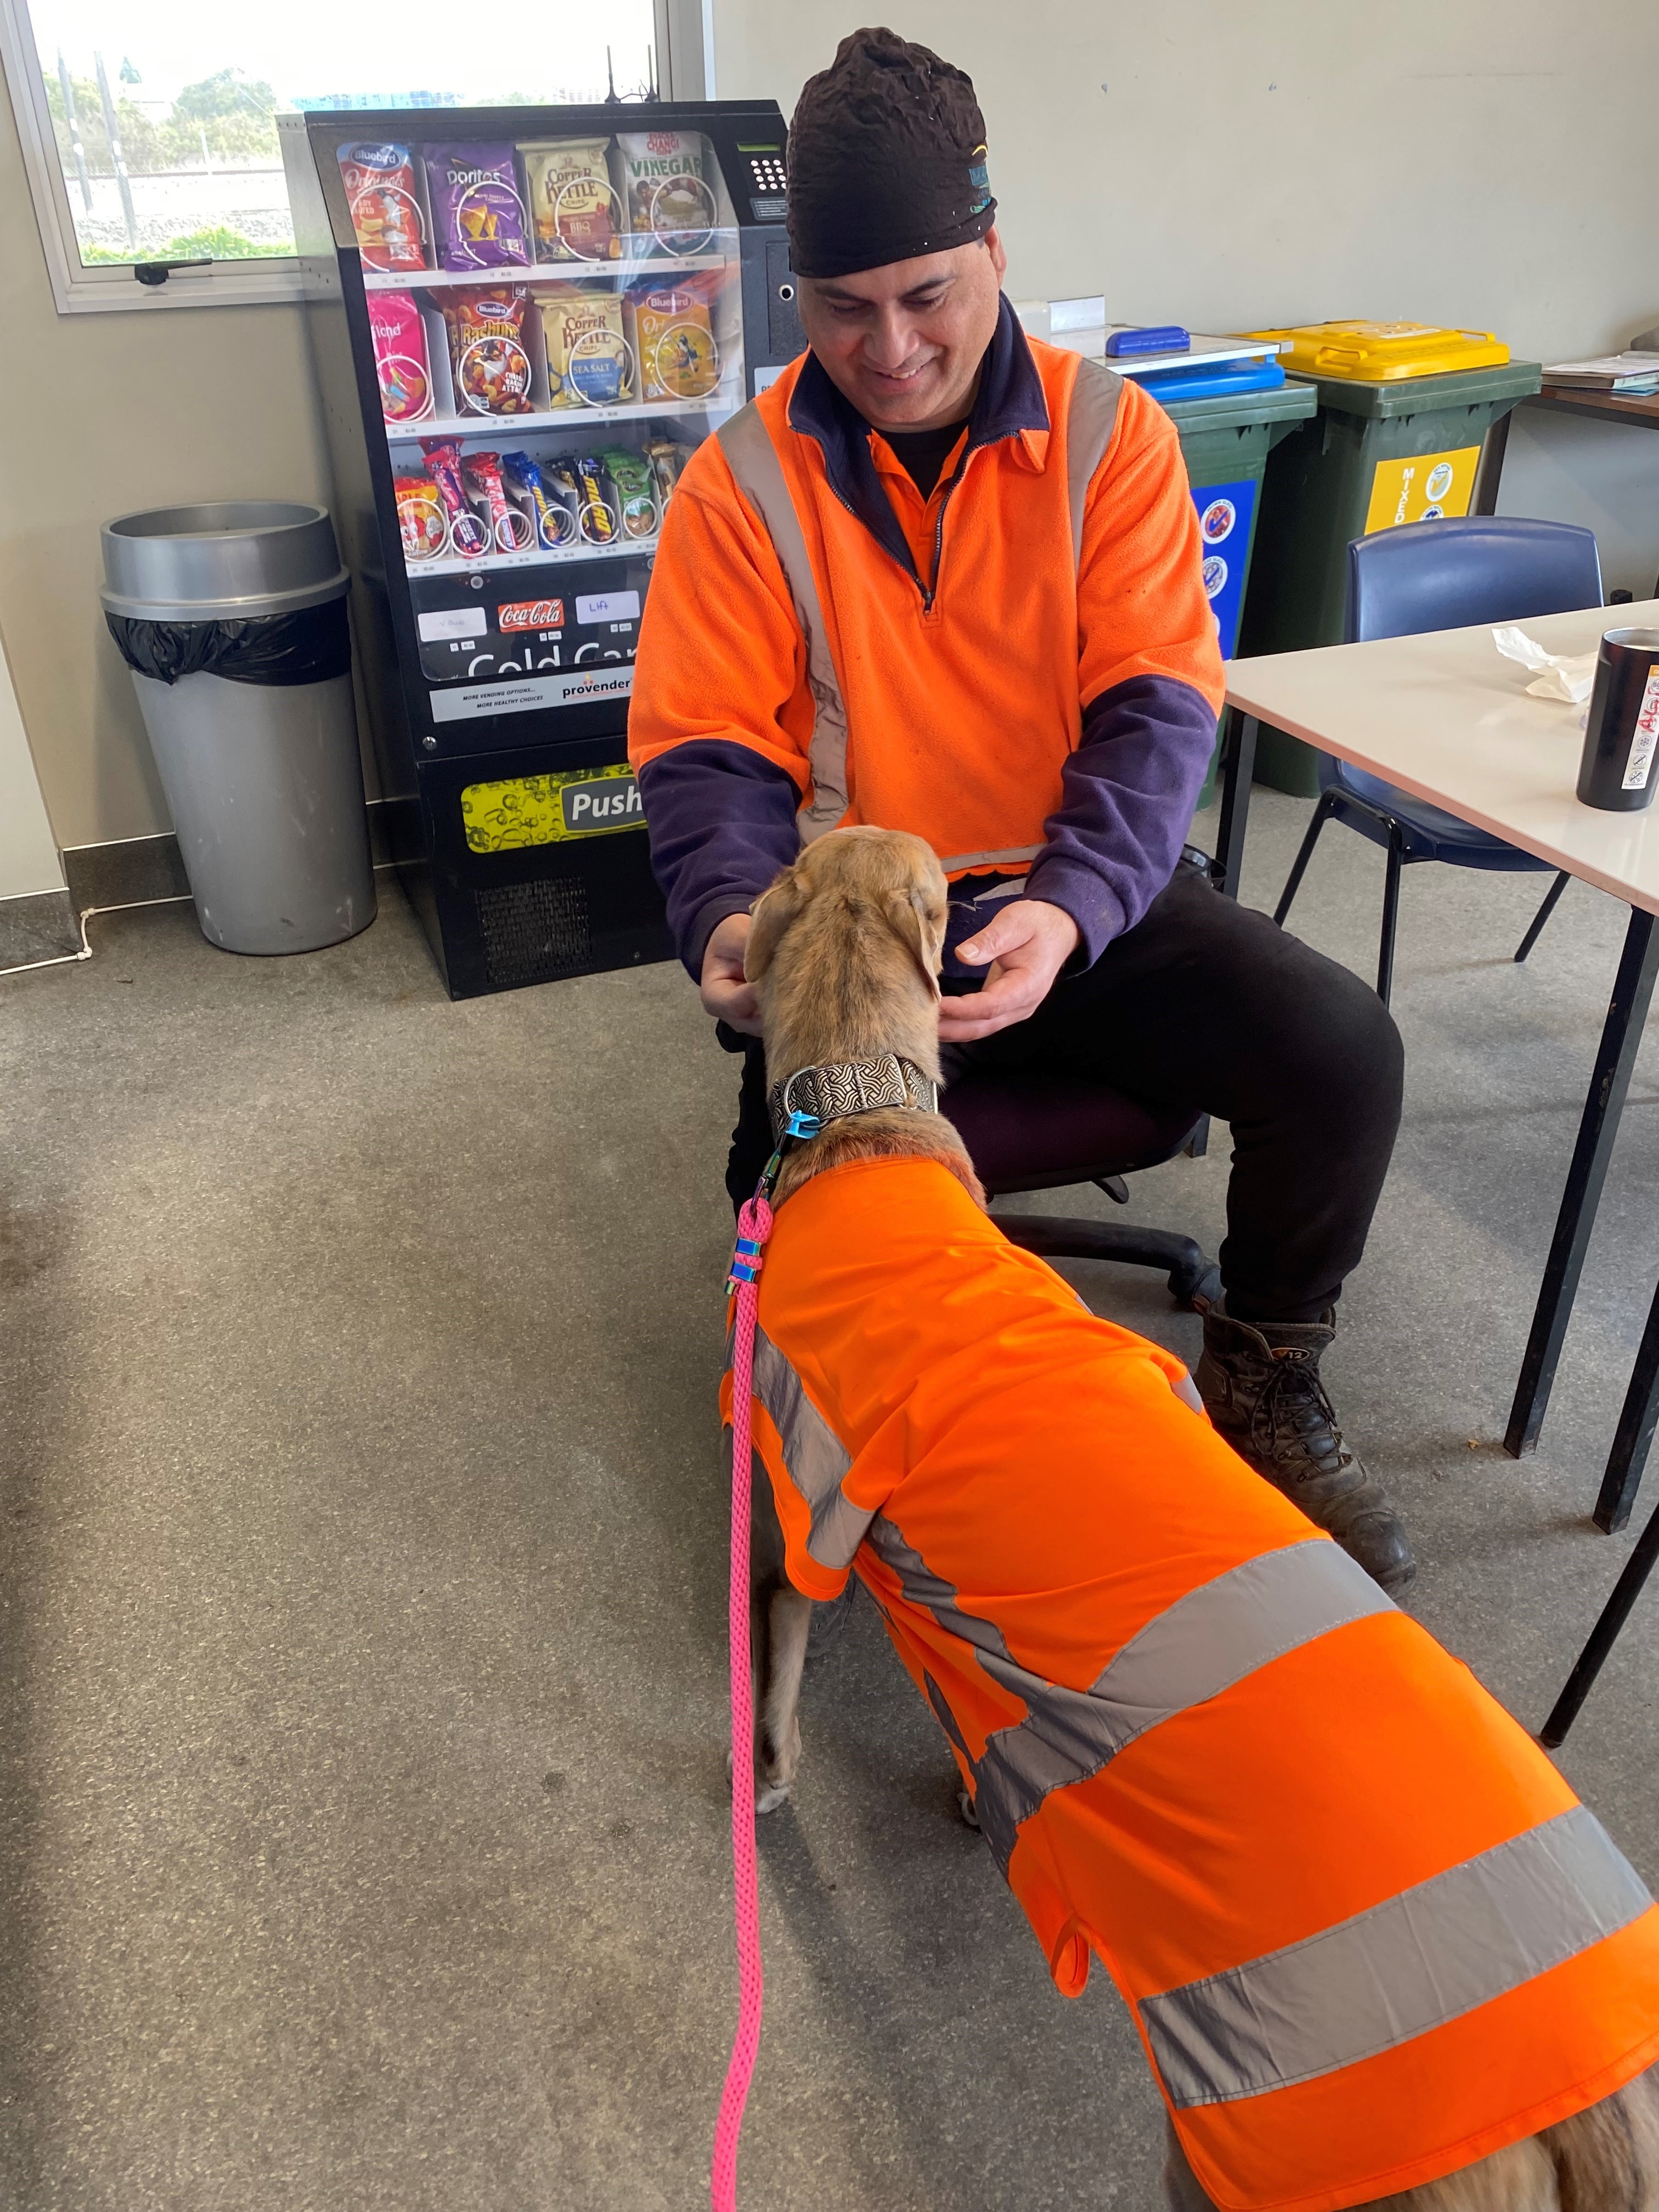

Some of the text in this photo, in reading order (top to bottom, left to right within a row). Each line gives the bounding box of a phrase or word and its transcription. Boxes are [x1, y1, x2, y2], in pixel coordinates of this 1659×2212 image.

[447, 170, 501, 185] Doritos
[478, 305, 507, 314] Bluebird
[651, 297, 689, 307] Blueird
[590, 363, 610, 373] SALT
[1394, 467, 1415, 524] MIXED
[459, 508, 477, 539] SERBERT
[499, 599, 562, 628] Coca-Cola
[563, 680, 630, 699] provender
[572, 786, 642, 821] Push
